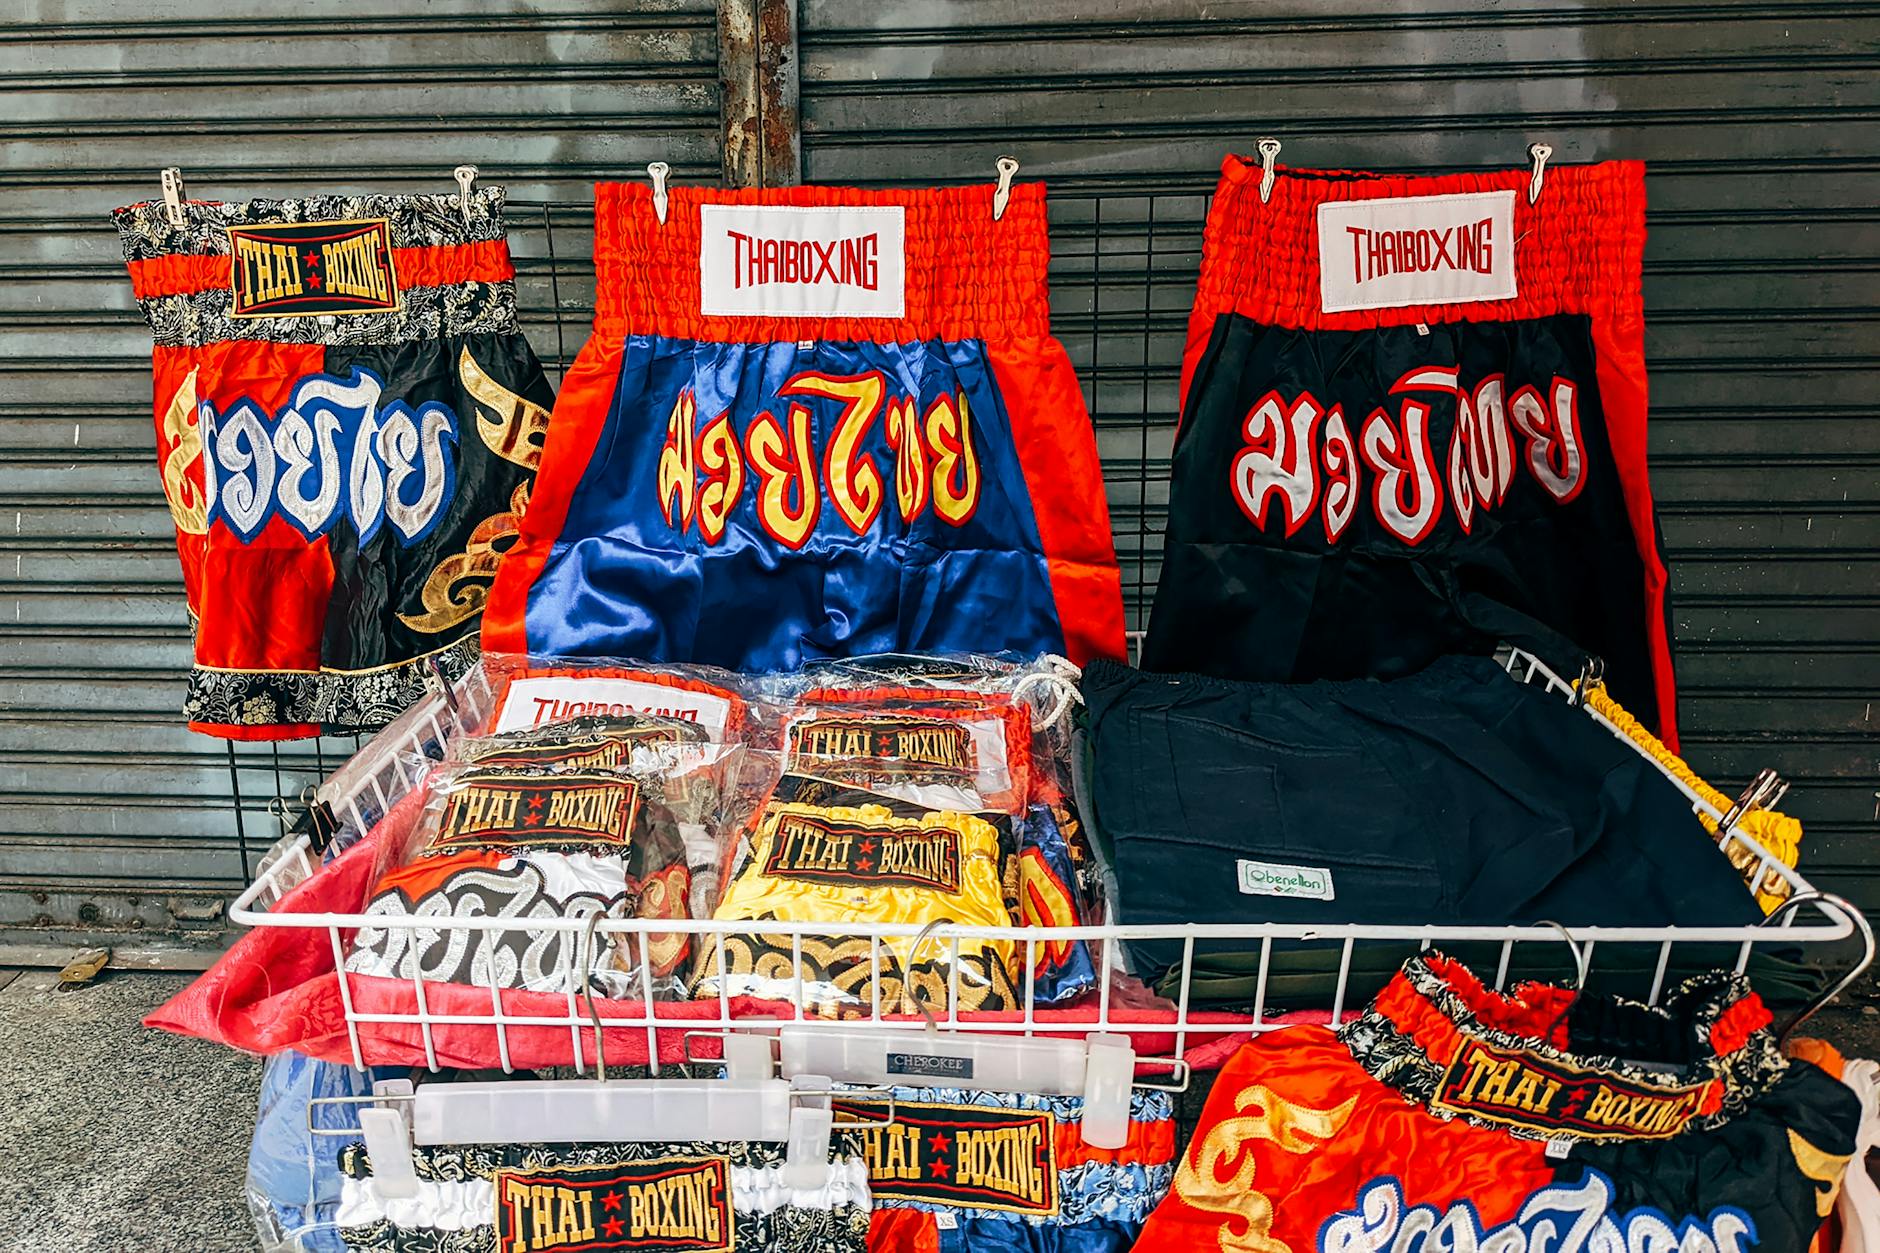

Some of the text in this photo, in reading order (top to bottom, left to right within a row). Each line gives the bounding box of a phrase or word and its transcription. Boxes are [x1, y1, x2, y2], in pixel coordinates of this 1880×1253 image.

[236, 229, 389, 307] THAI BOXING
[727, 229, 878, 291] THAIBOXING
[1346, 217, 1493, 284] THAIBOXING
[807, 727, 872, 758] THAI
[443, 786, 624, 839] THAI BOXING
[777, 819, 952, 886] THAI BOXING
[894, 1055, 964, 1070] CHEROKEE
[1457, 1048, 1694, 1134] THAI BOXING
[955, 1123, 1043, 1203] BOXING
[506, 1166, 720, 1253] THAI BOXING
[939, 1216, 954, 1227] XS
